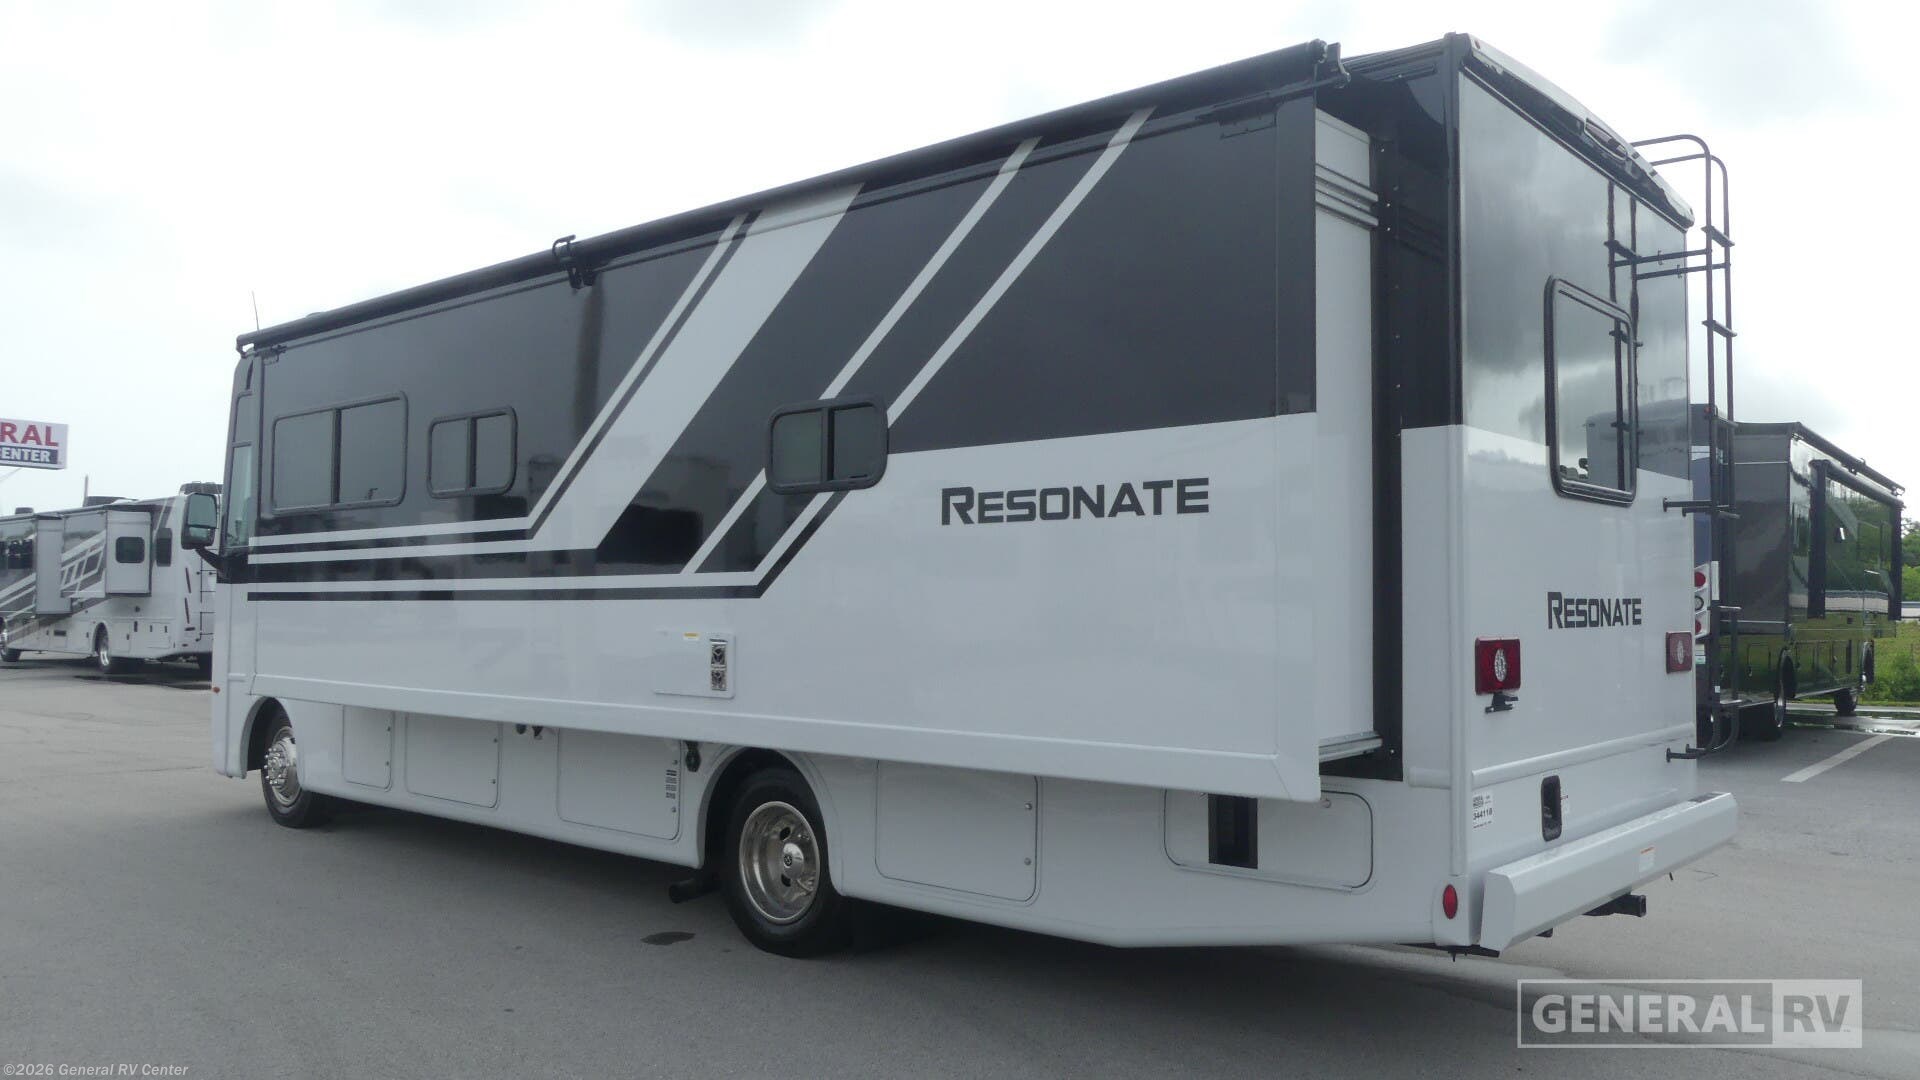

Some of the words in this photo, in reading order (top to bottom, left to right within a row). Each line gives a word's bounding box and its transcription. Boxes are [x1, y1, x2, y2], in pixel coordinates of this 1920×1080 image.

[0, 447, 51, 462] ENTER
[942, 477, 1209, 526] RESONATE
[1547, 591, 1642, 630] RESONATE
